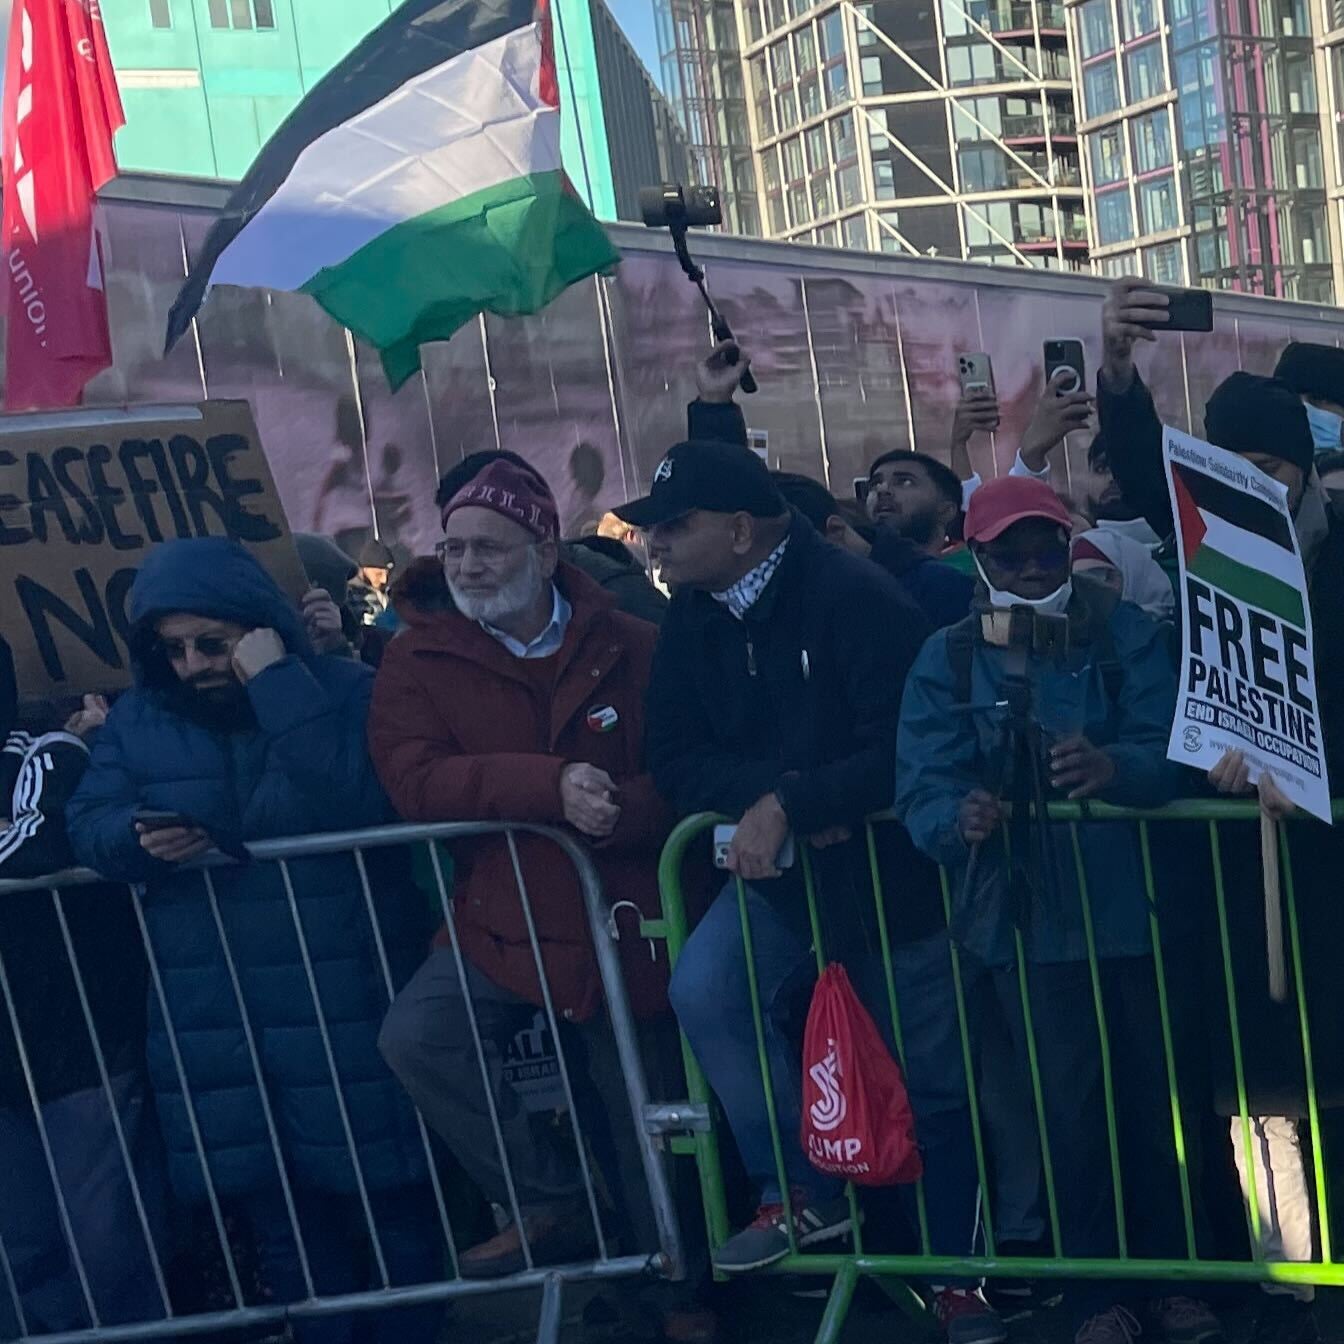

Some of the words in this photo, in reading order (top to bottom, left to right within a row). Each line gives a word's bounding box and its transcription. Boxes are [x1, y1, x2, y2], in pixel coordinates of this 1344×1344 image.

[1186, 575, 1313, 716] FREE
[1186, 701, 1215, 723] END
[1188, 657, 1319, 753] PALESTINE
